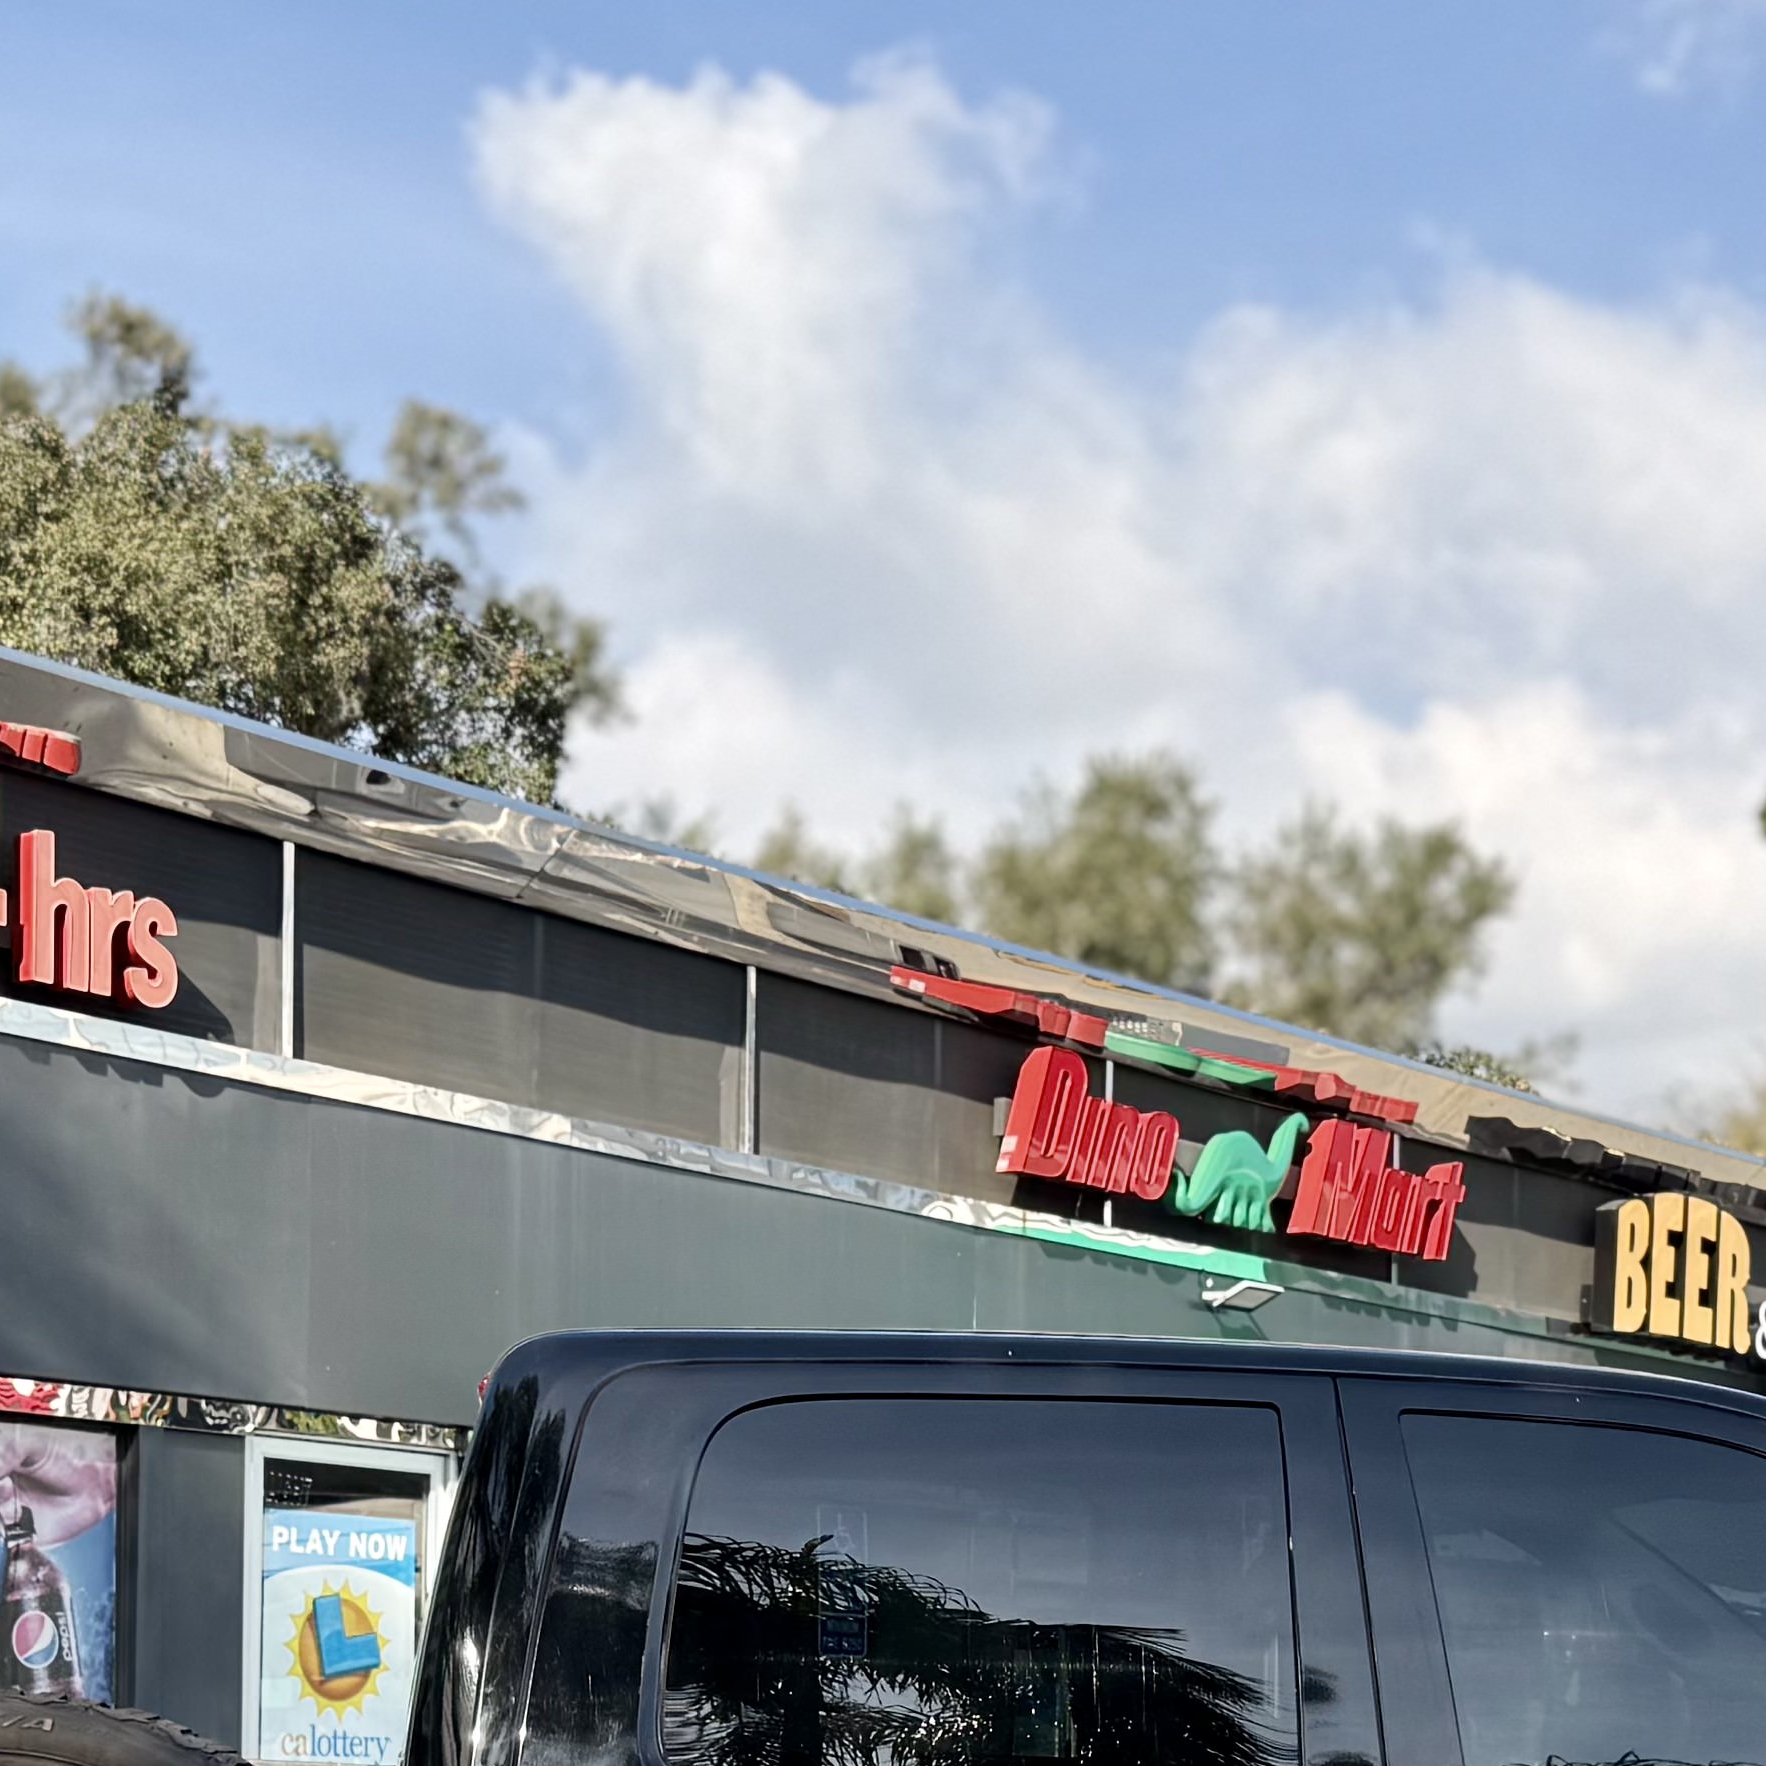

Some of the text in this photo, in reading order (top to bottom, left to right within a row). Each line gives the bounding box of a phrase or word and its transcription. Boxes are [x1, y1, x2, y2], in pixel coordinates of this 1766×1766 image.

[18, 829, 179, 1009] hrs
[1598, 1192, 1752, 1355] BEER
[272, 1525, 408, 1561] PLAY NOW
[55, 1611, 73, 1661] pepsi
[280, 1724, 393, 1760] calottery
